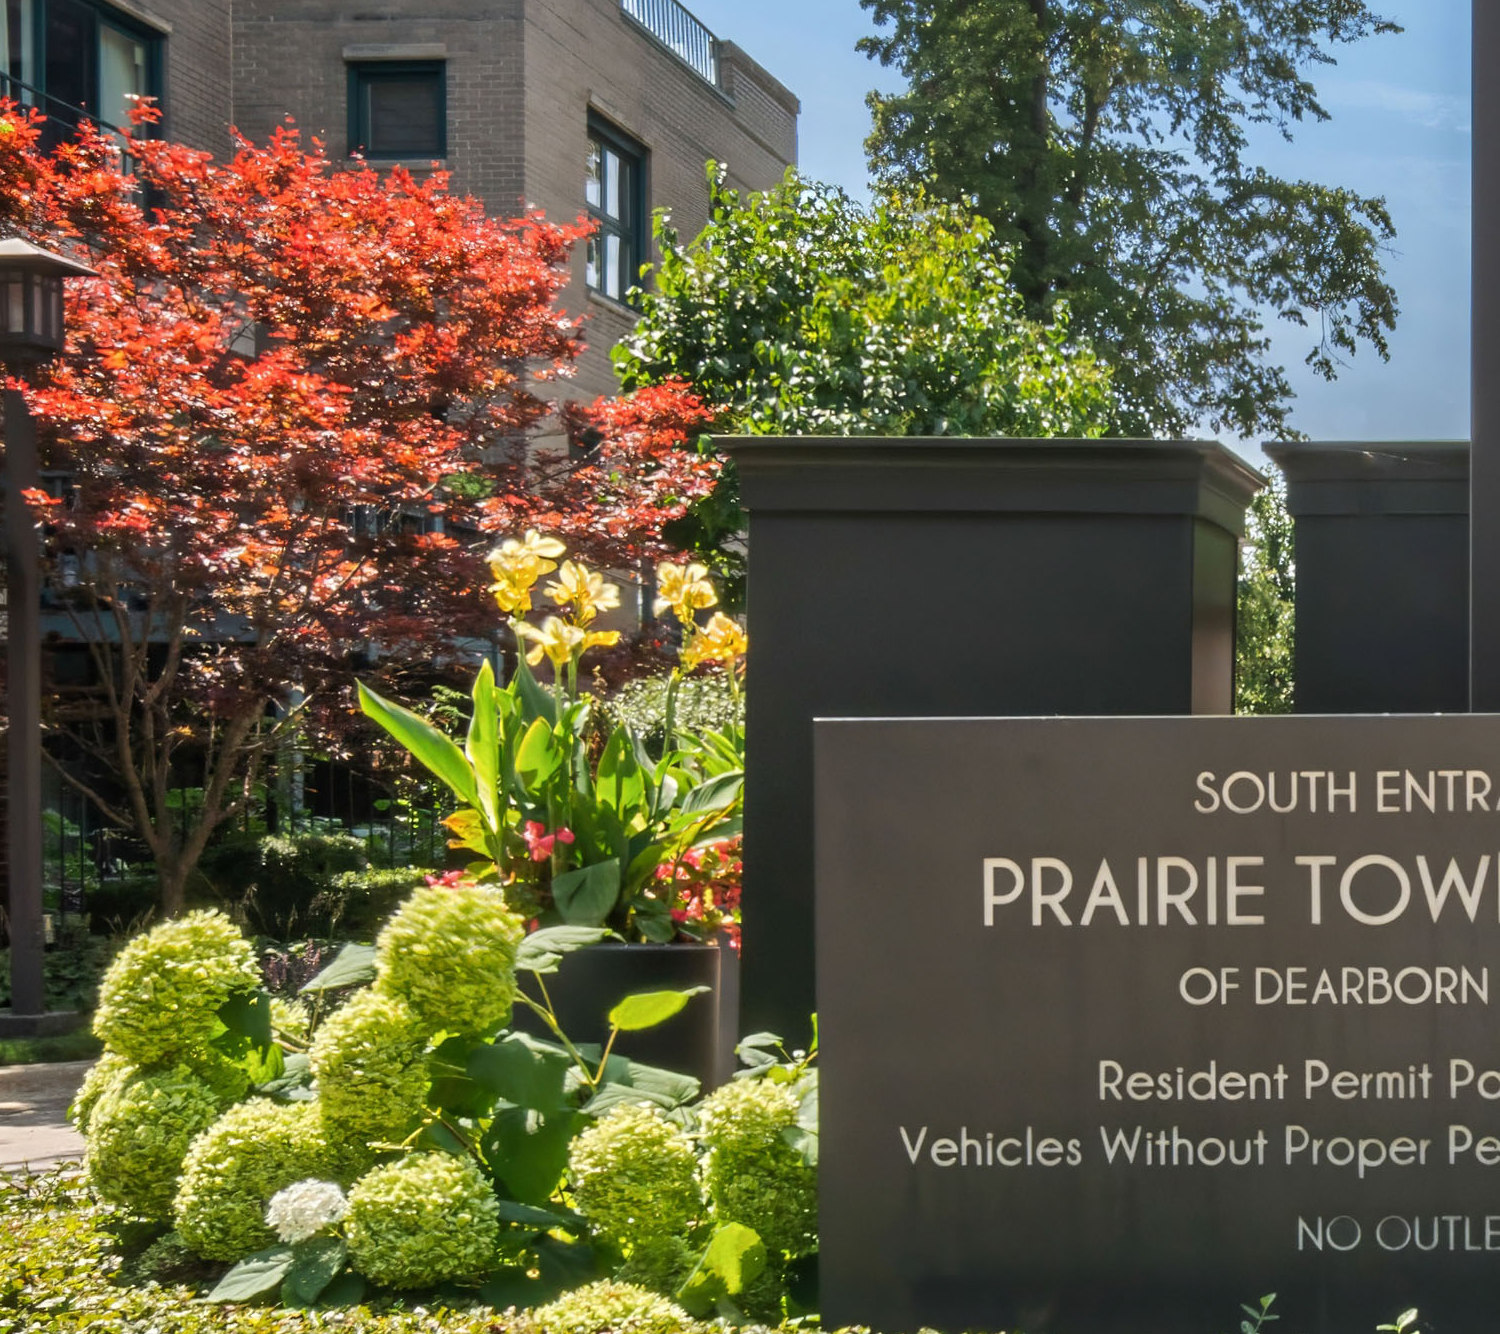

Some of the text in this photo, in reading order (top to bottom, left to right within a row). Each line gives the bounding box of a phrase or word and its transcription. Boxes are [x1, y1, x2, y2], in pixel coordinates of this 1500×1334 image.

[1194, 770, 1357, 814] SOUTH
[983, 856, 1266, 927] PRAIRIE
[1179, 967, 1240, 1005] OF
[1255, 965, 1489, 1006] DEARBORN
[1098, 1059, 1289, 1101] Resident
[1304, 1058, 1433, 1100] Permit
[899, 1125, 1082, 1167] Vehicles
[1099, 1125, 1269, 1167] Without
[1285, 1124, 1431, 1179] Proper
[1297, 1216, 1362, 1252] NO
